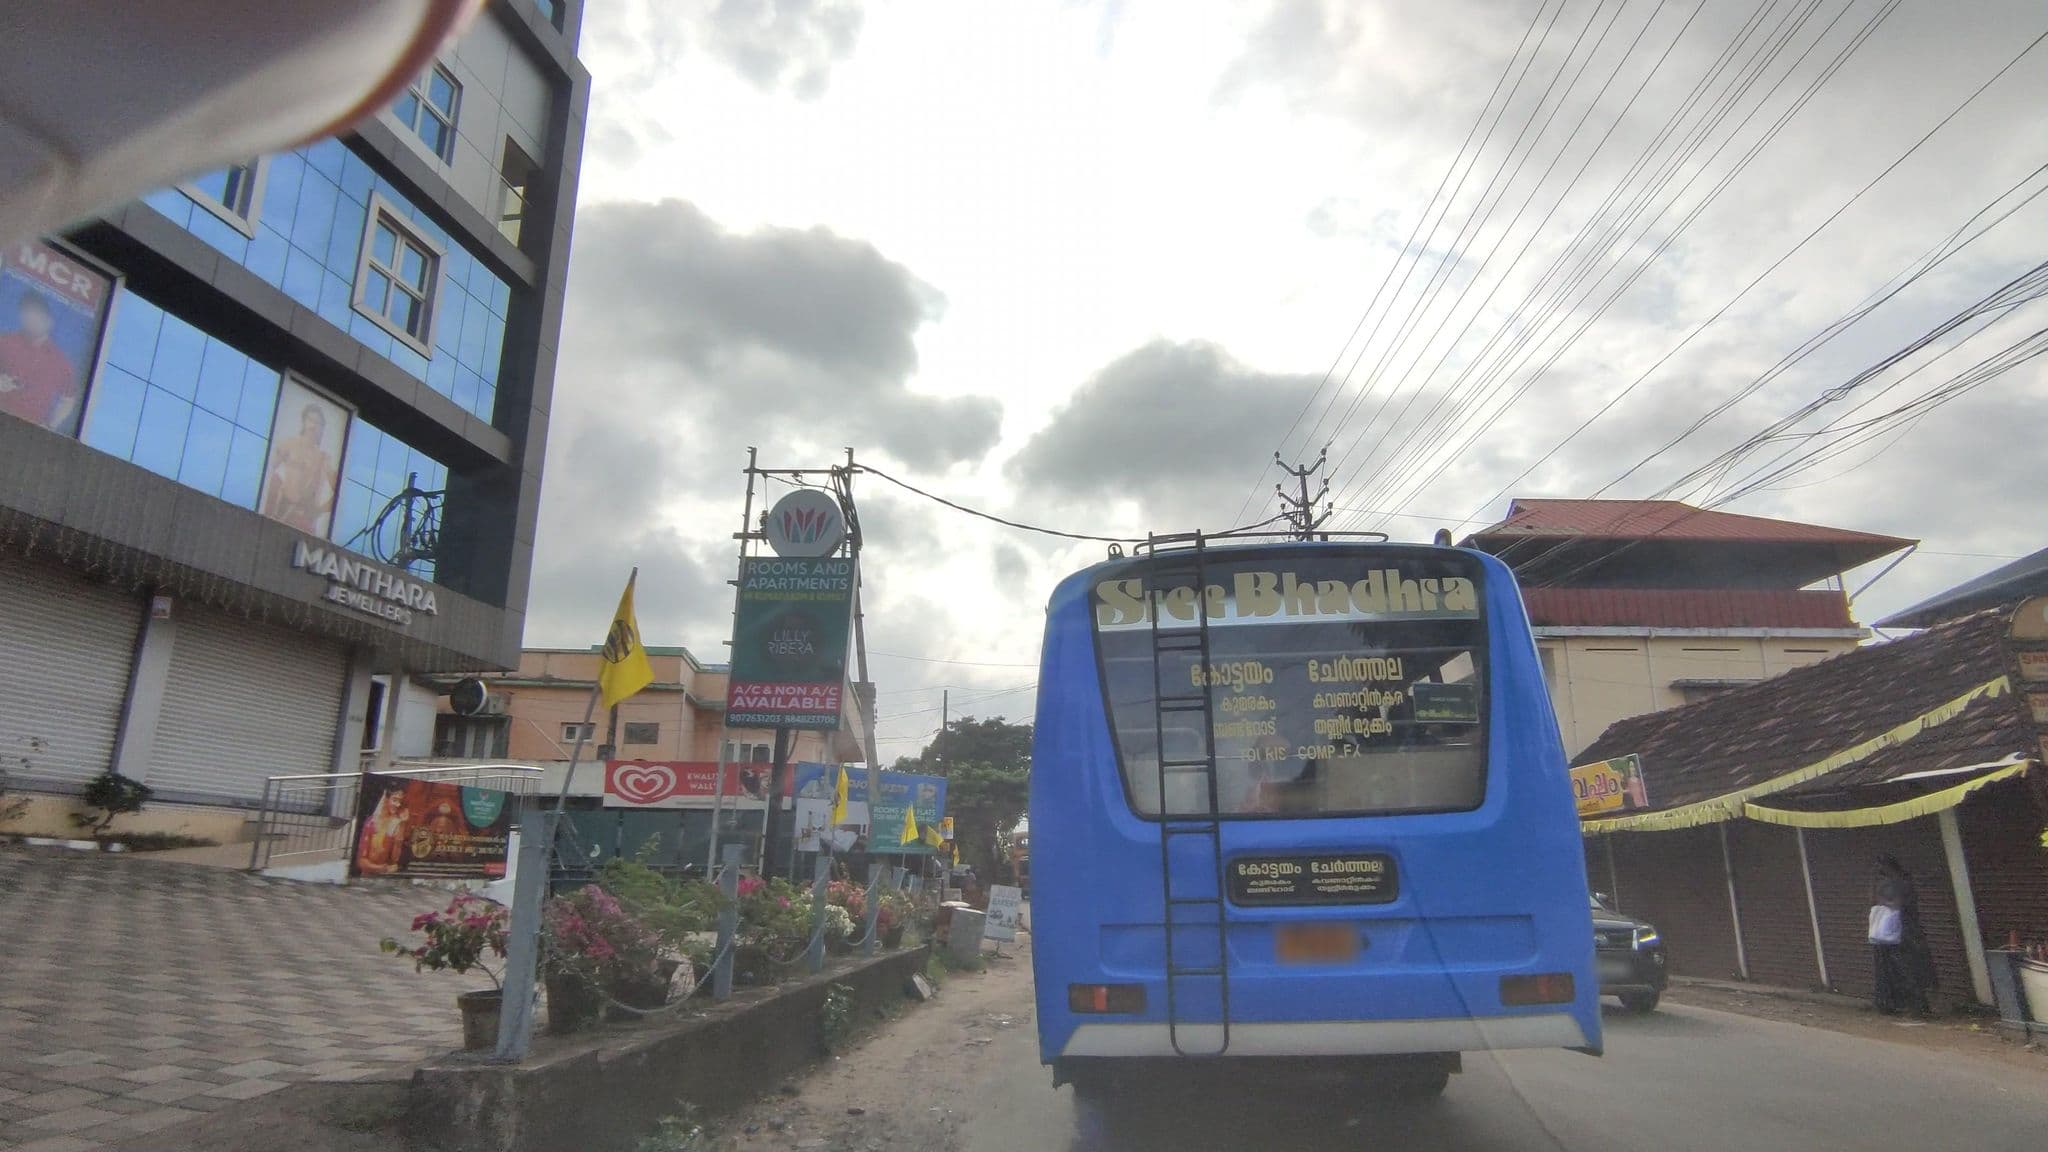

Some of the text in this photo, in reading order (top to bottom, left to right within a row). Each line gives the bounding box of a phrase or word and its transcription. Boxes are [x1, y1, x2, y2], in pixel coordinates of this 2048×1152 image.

[19, 244, 92, 300] MCR
[748, 561, 849, 575] ROOMS AND
[293, 540, 438, 616] MANTHARA
[746, 577, 848, 590] APARTMENTS
[1096, 568, 1476, 625] Sree Bhadhra
[326, 584, 413, 626] JEWELLERS
[774, 629, 810, 642] LILLY
[734, 684, 838, 697] A/C & NON A/C
[732, 696, 837, 709] AVAILABLE
[687, 772, 727, 780] KWALIT
[1238, 862, 1302, 878] കോട്ടയം
